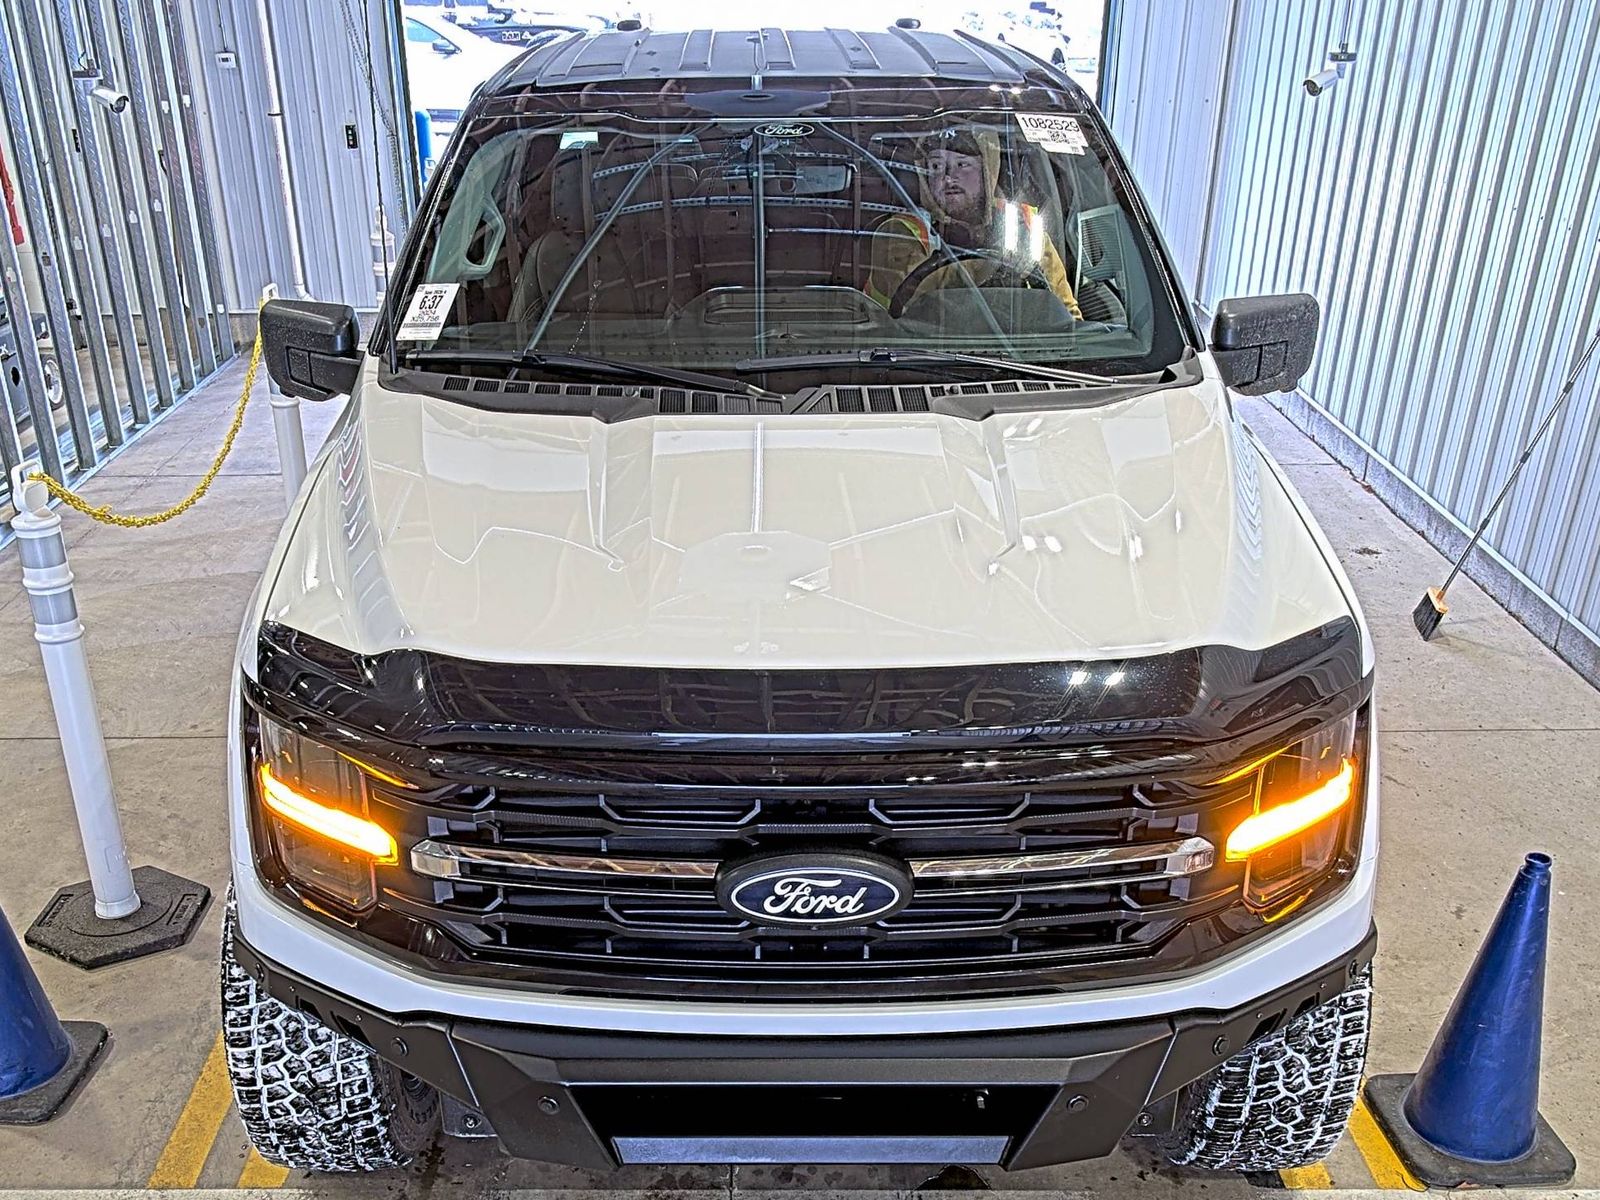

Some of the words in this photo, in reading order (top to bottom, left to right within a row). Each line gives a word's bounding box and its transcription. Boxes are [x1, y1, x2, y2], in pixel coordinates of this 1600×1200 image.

[764, 124, 804, 135] Ford
[1021, 117, 1080, 132] 1082529
[763, 877, 867, 914] Ford
